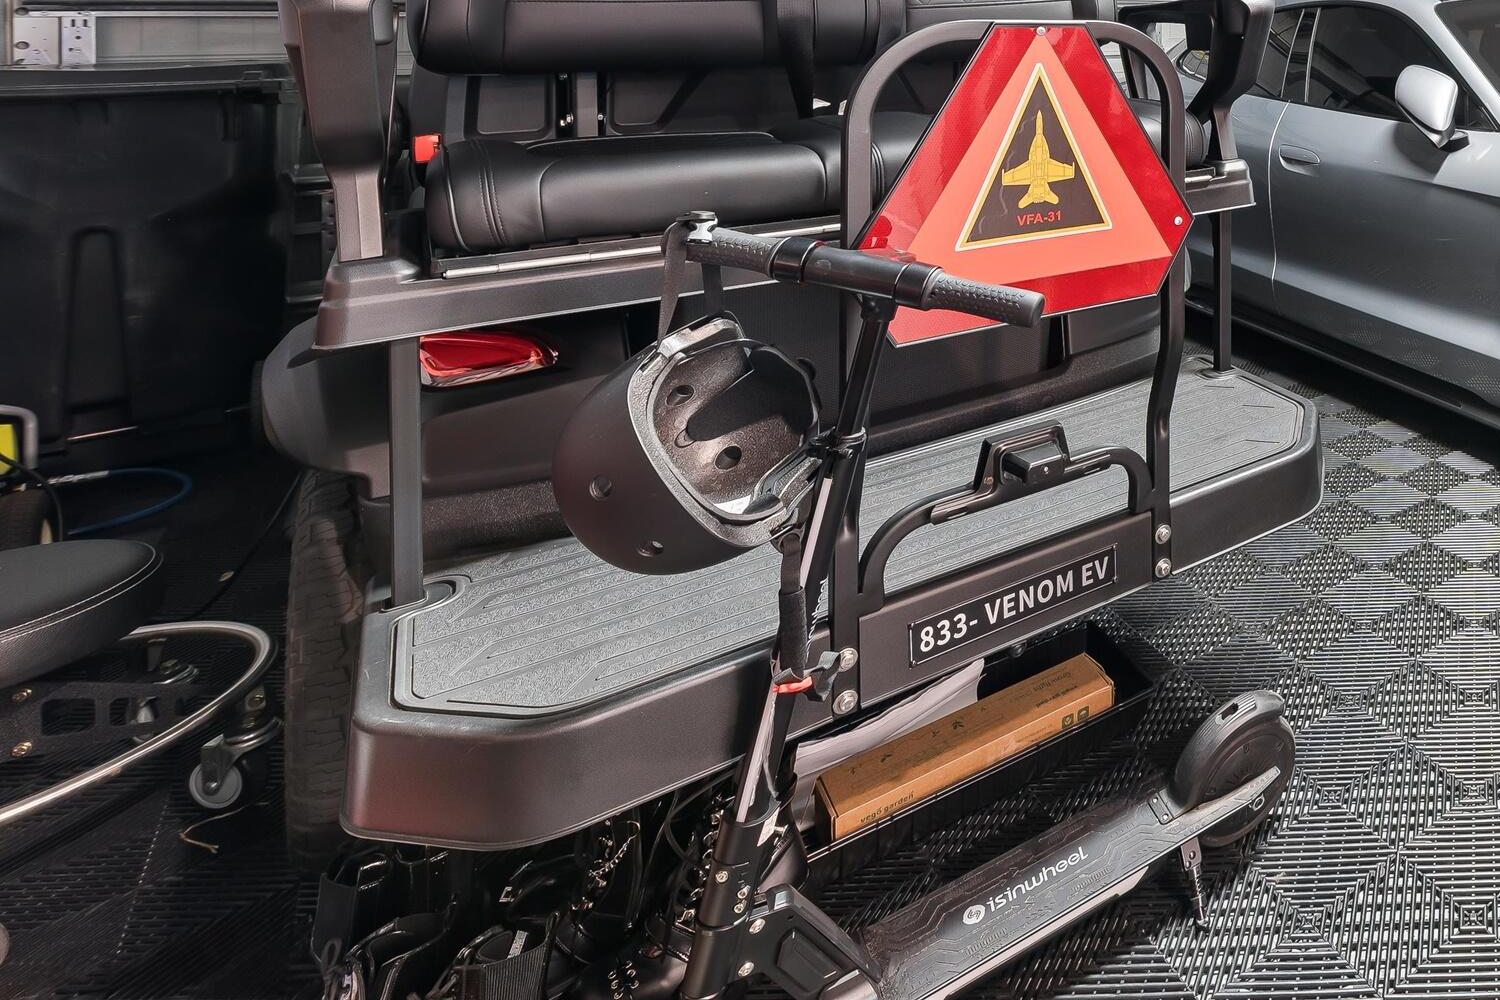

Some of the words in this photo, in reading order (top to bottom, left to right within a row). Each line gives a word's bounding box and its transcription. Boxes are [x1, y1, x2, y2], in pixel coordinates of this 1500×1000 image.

[1017, 210, 1062, 226] VFA-31
[919, 613, 978, 652] 833-
[984, 570, 1074, 625] VENOM
[1081, 556, 1109, 587] EV
[987, 846, 1089, 912] isinwheel
